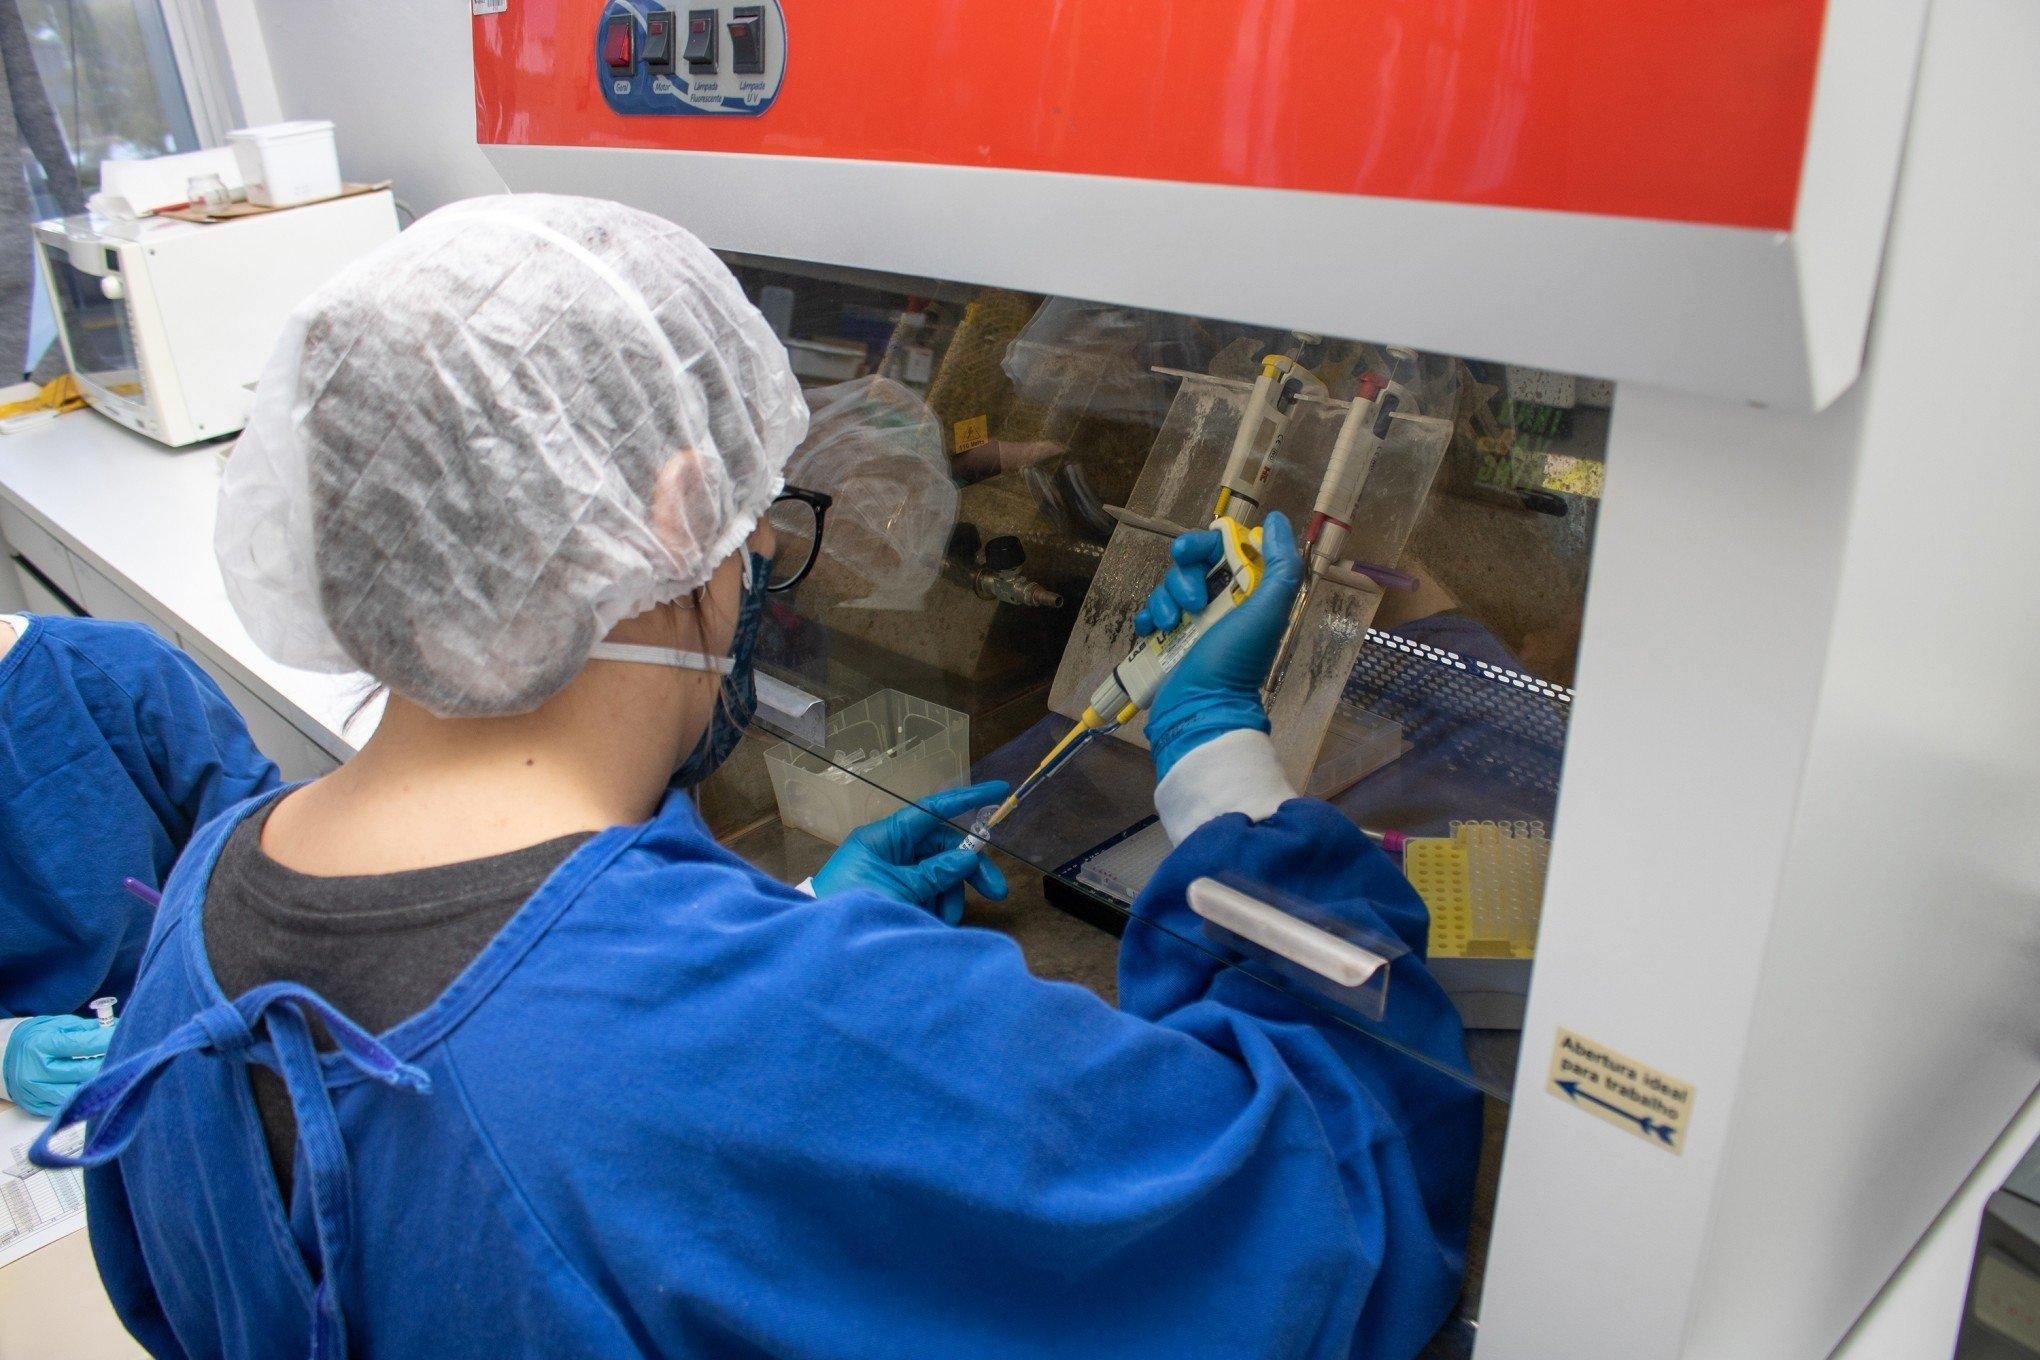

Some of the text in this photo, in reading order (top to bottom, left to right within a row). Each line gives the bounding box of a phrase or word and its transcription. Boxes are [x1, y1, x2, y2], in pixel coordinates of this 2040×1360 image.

[1560, 1058, 1678, 1120] para trabalho
[1562, 1037, 1687, 1103] Abertura ideal
